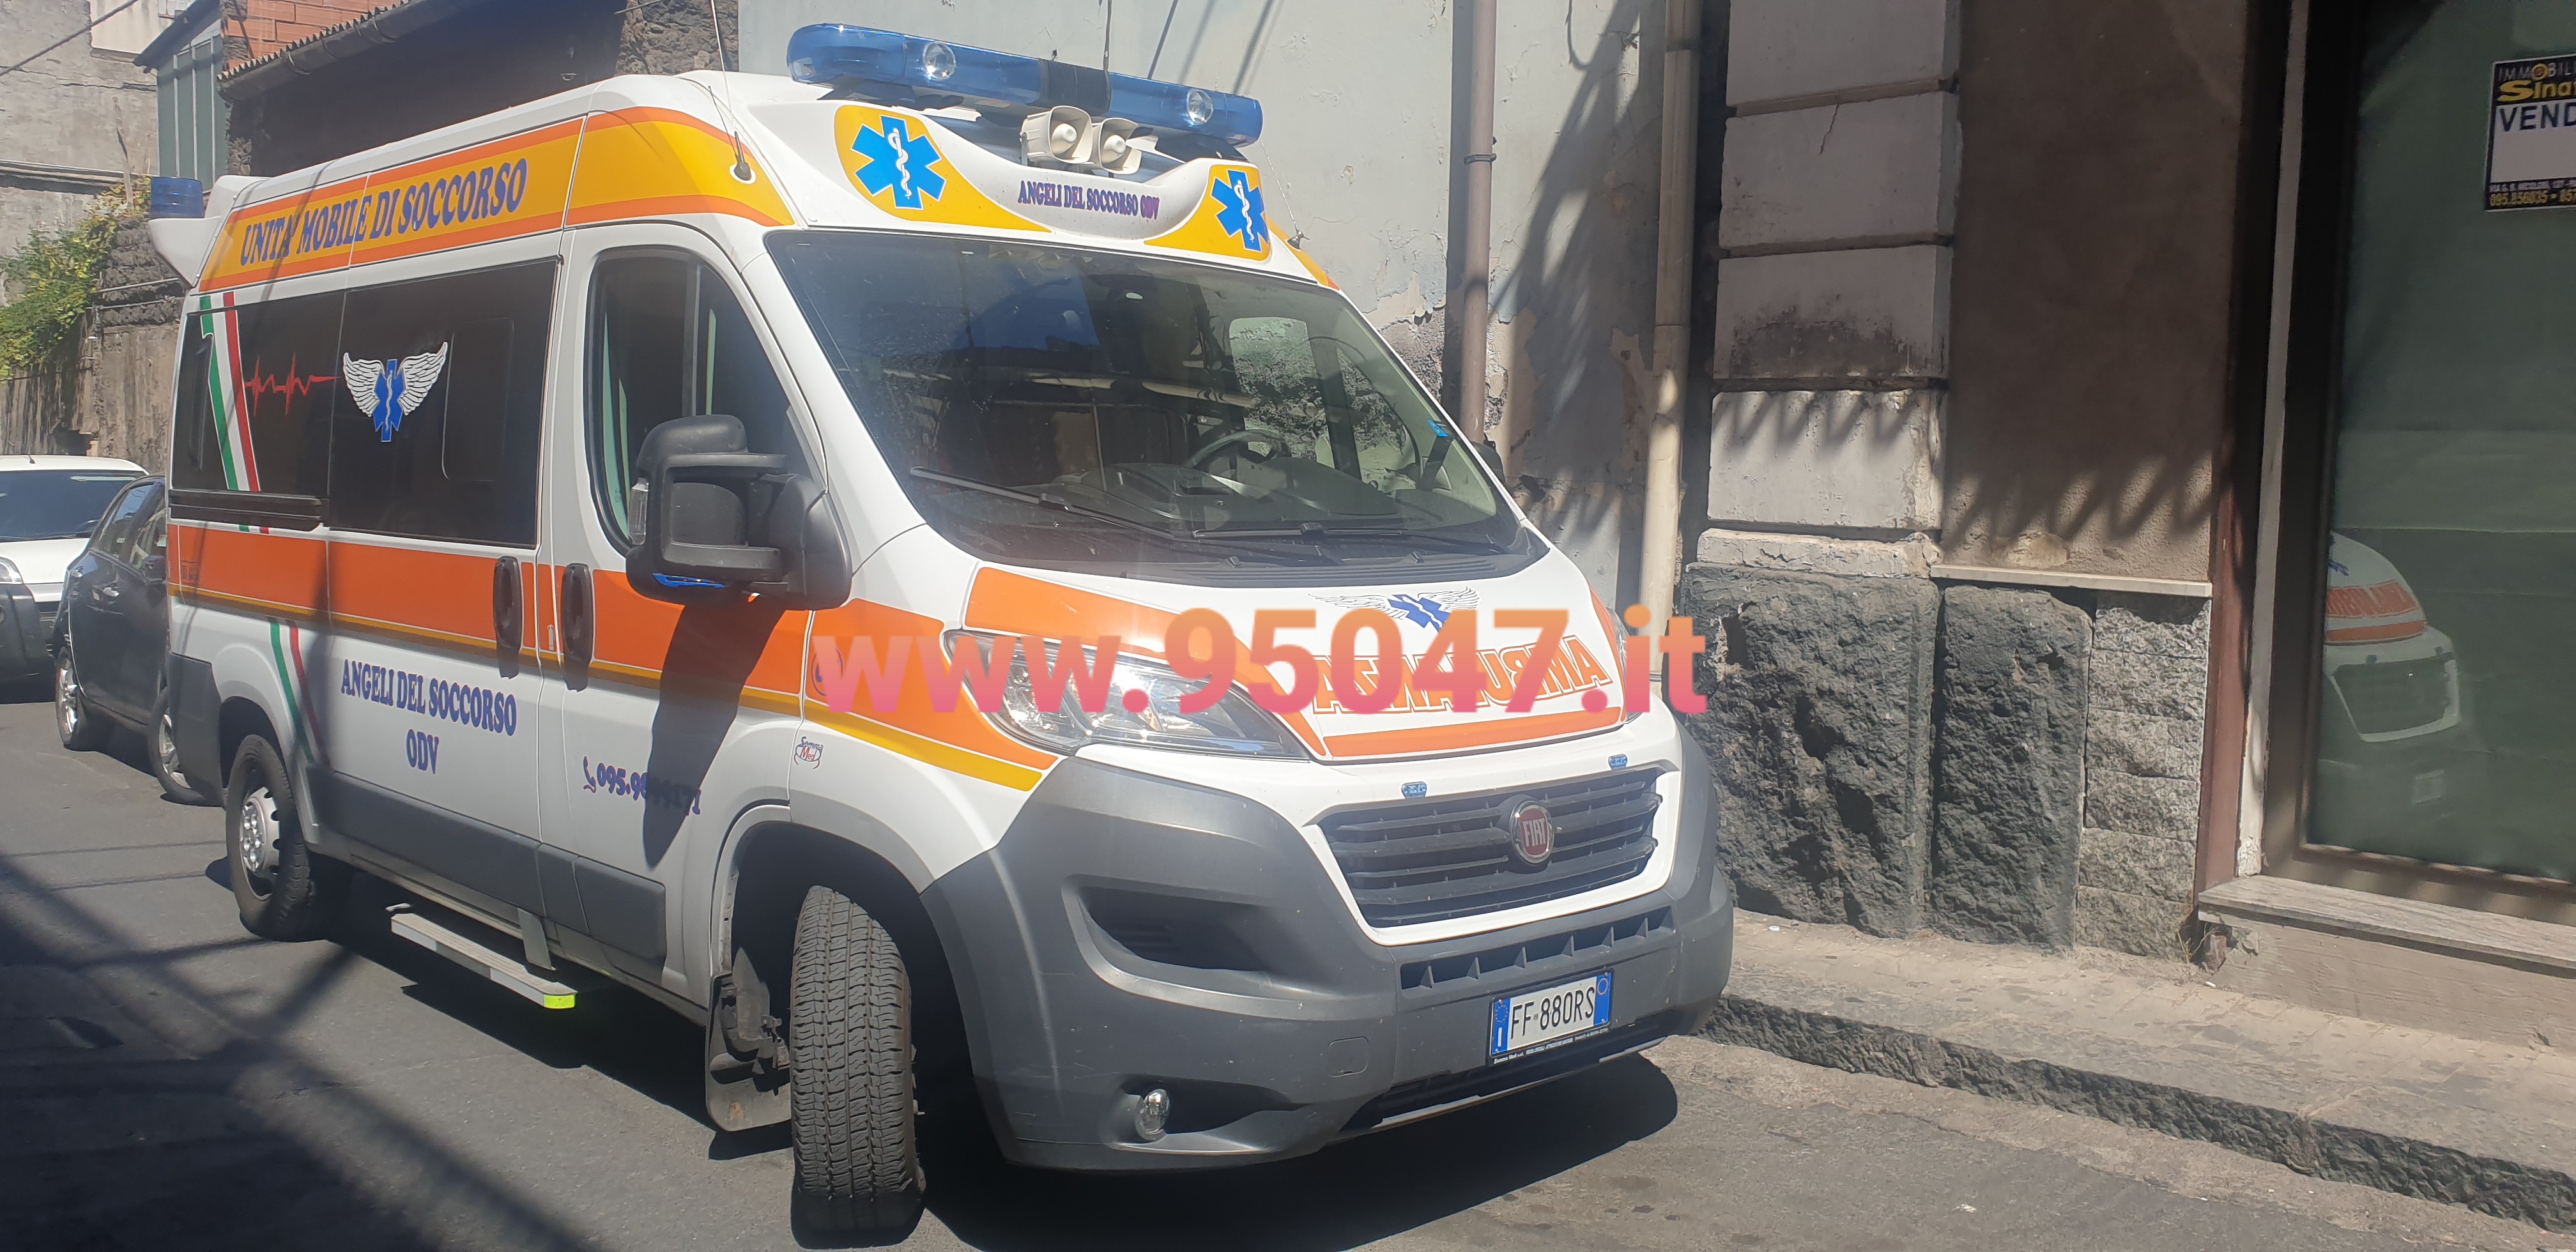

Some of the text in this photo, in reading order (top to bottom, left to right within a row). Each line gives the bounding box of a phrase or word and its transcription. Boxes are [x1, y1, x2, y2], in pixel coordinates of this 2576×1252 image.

[2497, 80, 2576, 102] Sina
[296, 194, 371, 255] MOBILE
[369, 189, 400, 240] DI
[397, 158, 528, 234] SOCCORSO
[1018, 180, 1160, 220] ANGELI DEL SOCCORSO ODV
[341, 659, 518, 737] ANGELI DEL SOCCORSO
[406, 729, 440, 775] ODV
[800, 745, 817, 761] Med
[1522, 818, 1546, 847] FIAT
